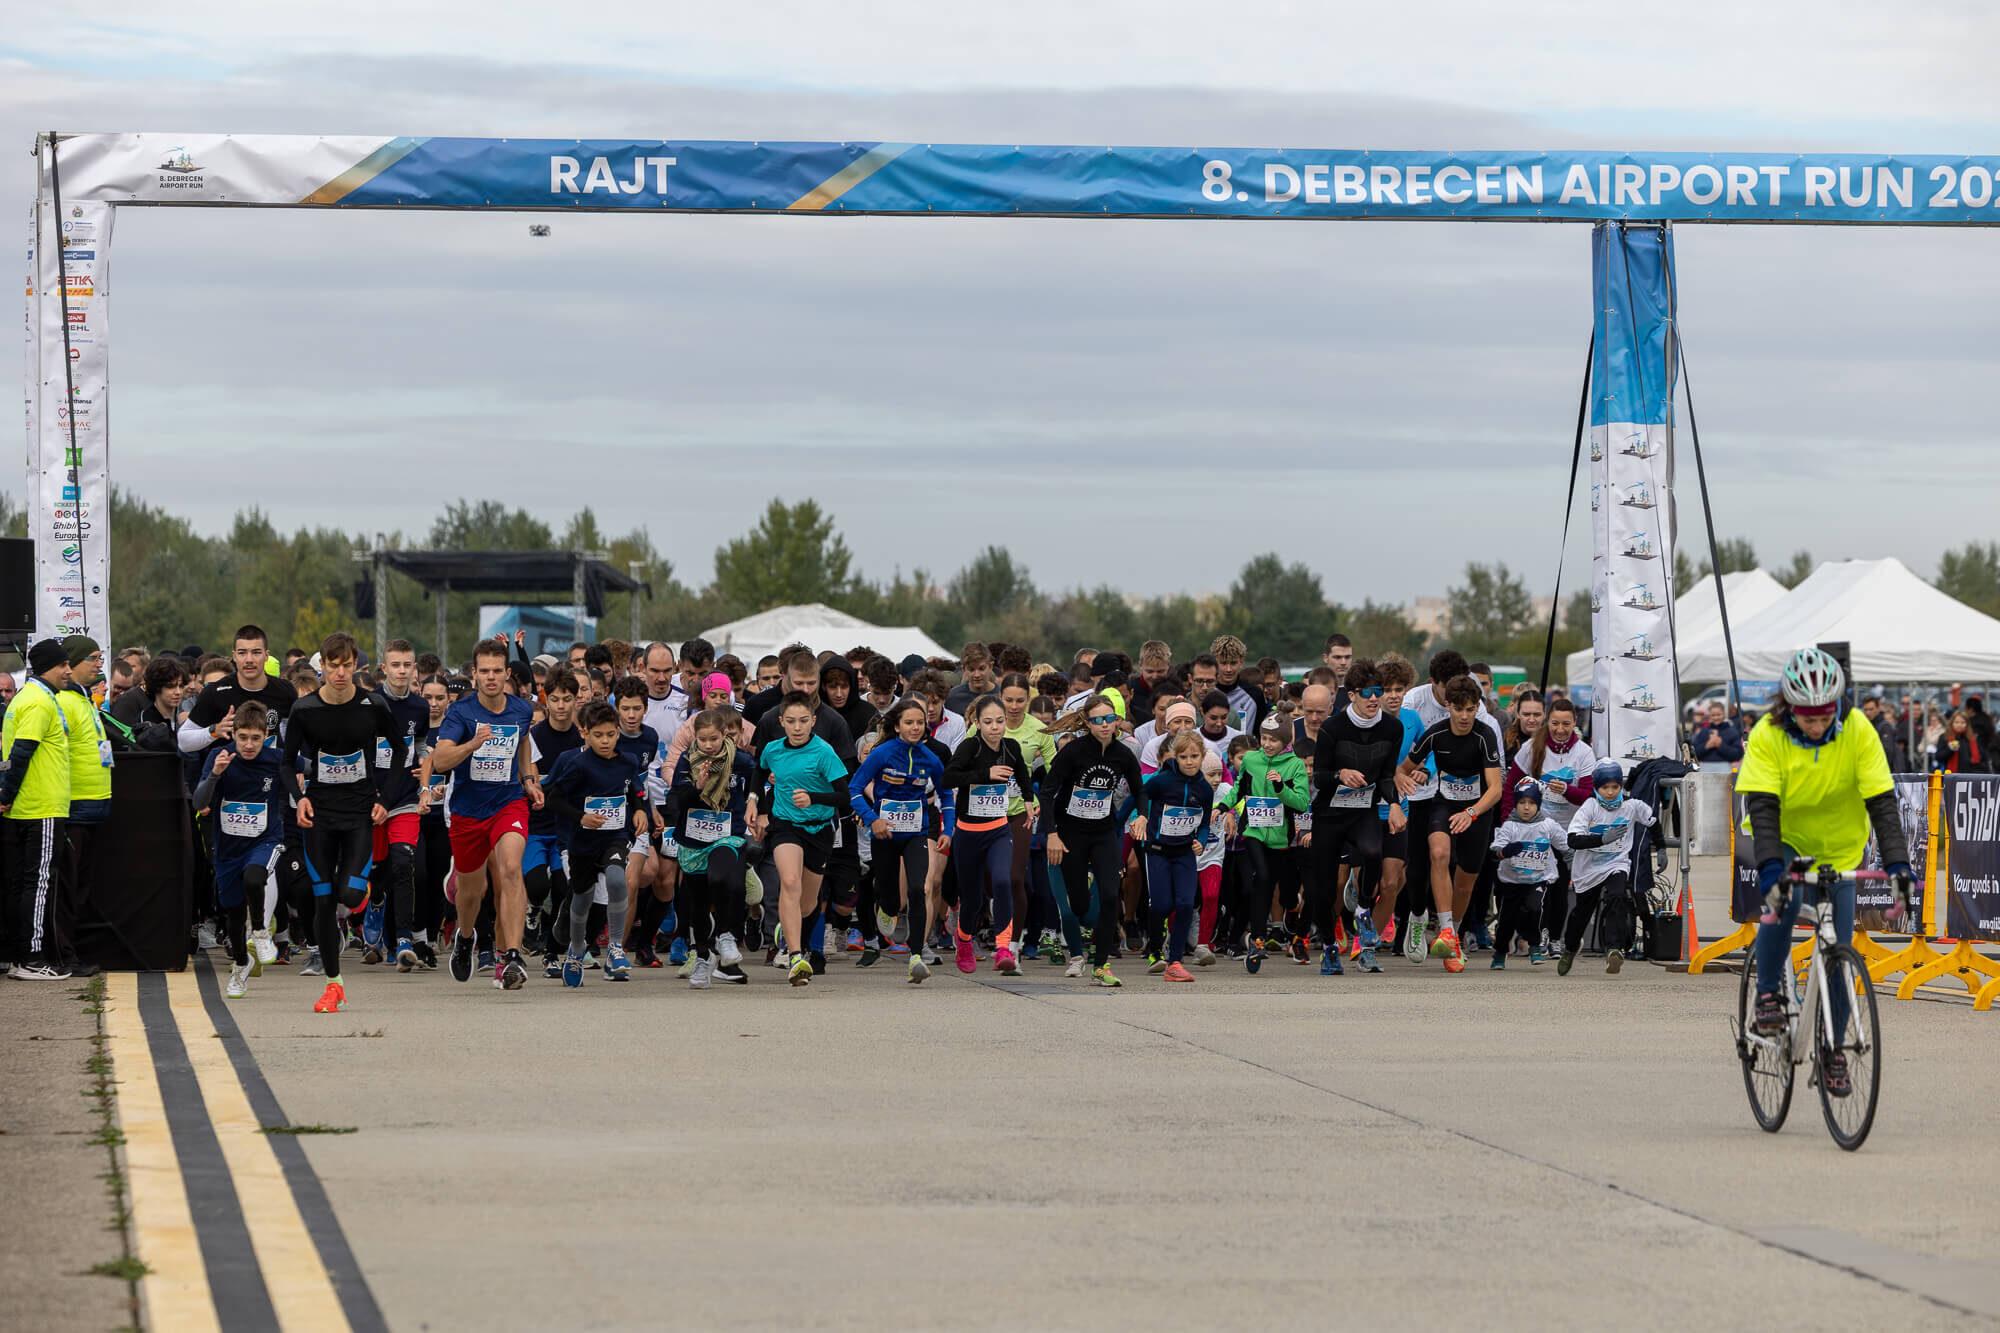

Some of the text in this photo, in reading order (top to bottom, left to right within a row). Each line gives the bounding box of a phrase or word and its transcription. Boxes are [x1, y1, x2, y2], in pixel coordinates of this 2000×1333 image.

[550, 155, 677, 195] RAJT
[1201, 159, 2000, 208] 8. DEBRECEN AIRPORT RUN 20
[326, 765, 358, 774] 2614
[476, 761, 505, 770] 3558
[1090, 776, 1111, 787] ADY
[977, 795, 1005, 805] 3769
[1077, 799, 1104, 809] 3650
[887, 812, 915, 821] 3189
[1249, 807, 1276, 817] 3218
[227, 814, 258, 825] 3252
[1169, 816, 1195, 825] 3770
[694, 819, 723, 832] 3256
[1953, 873, 1999, 899] Your goods in
